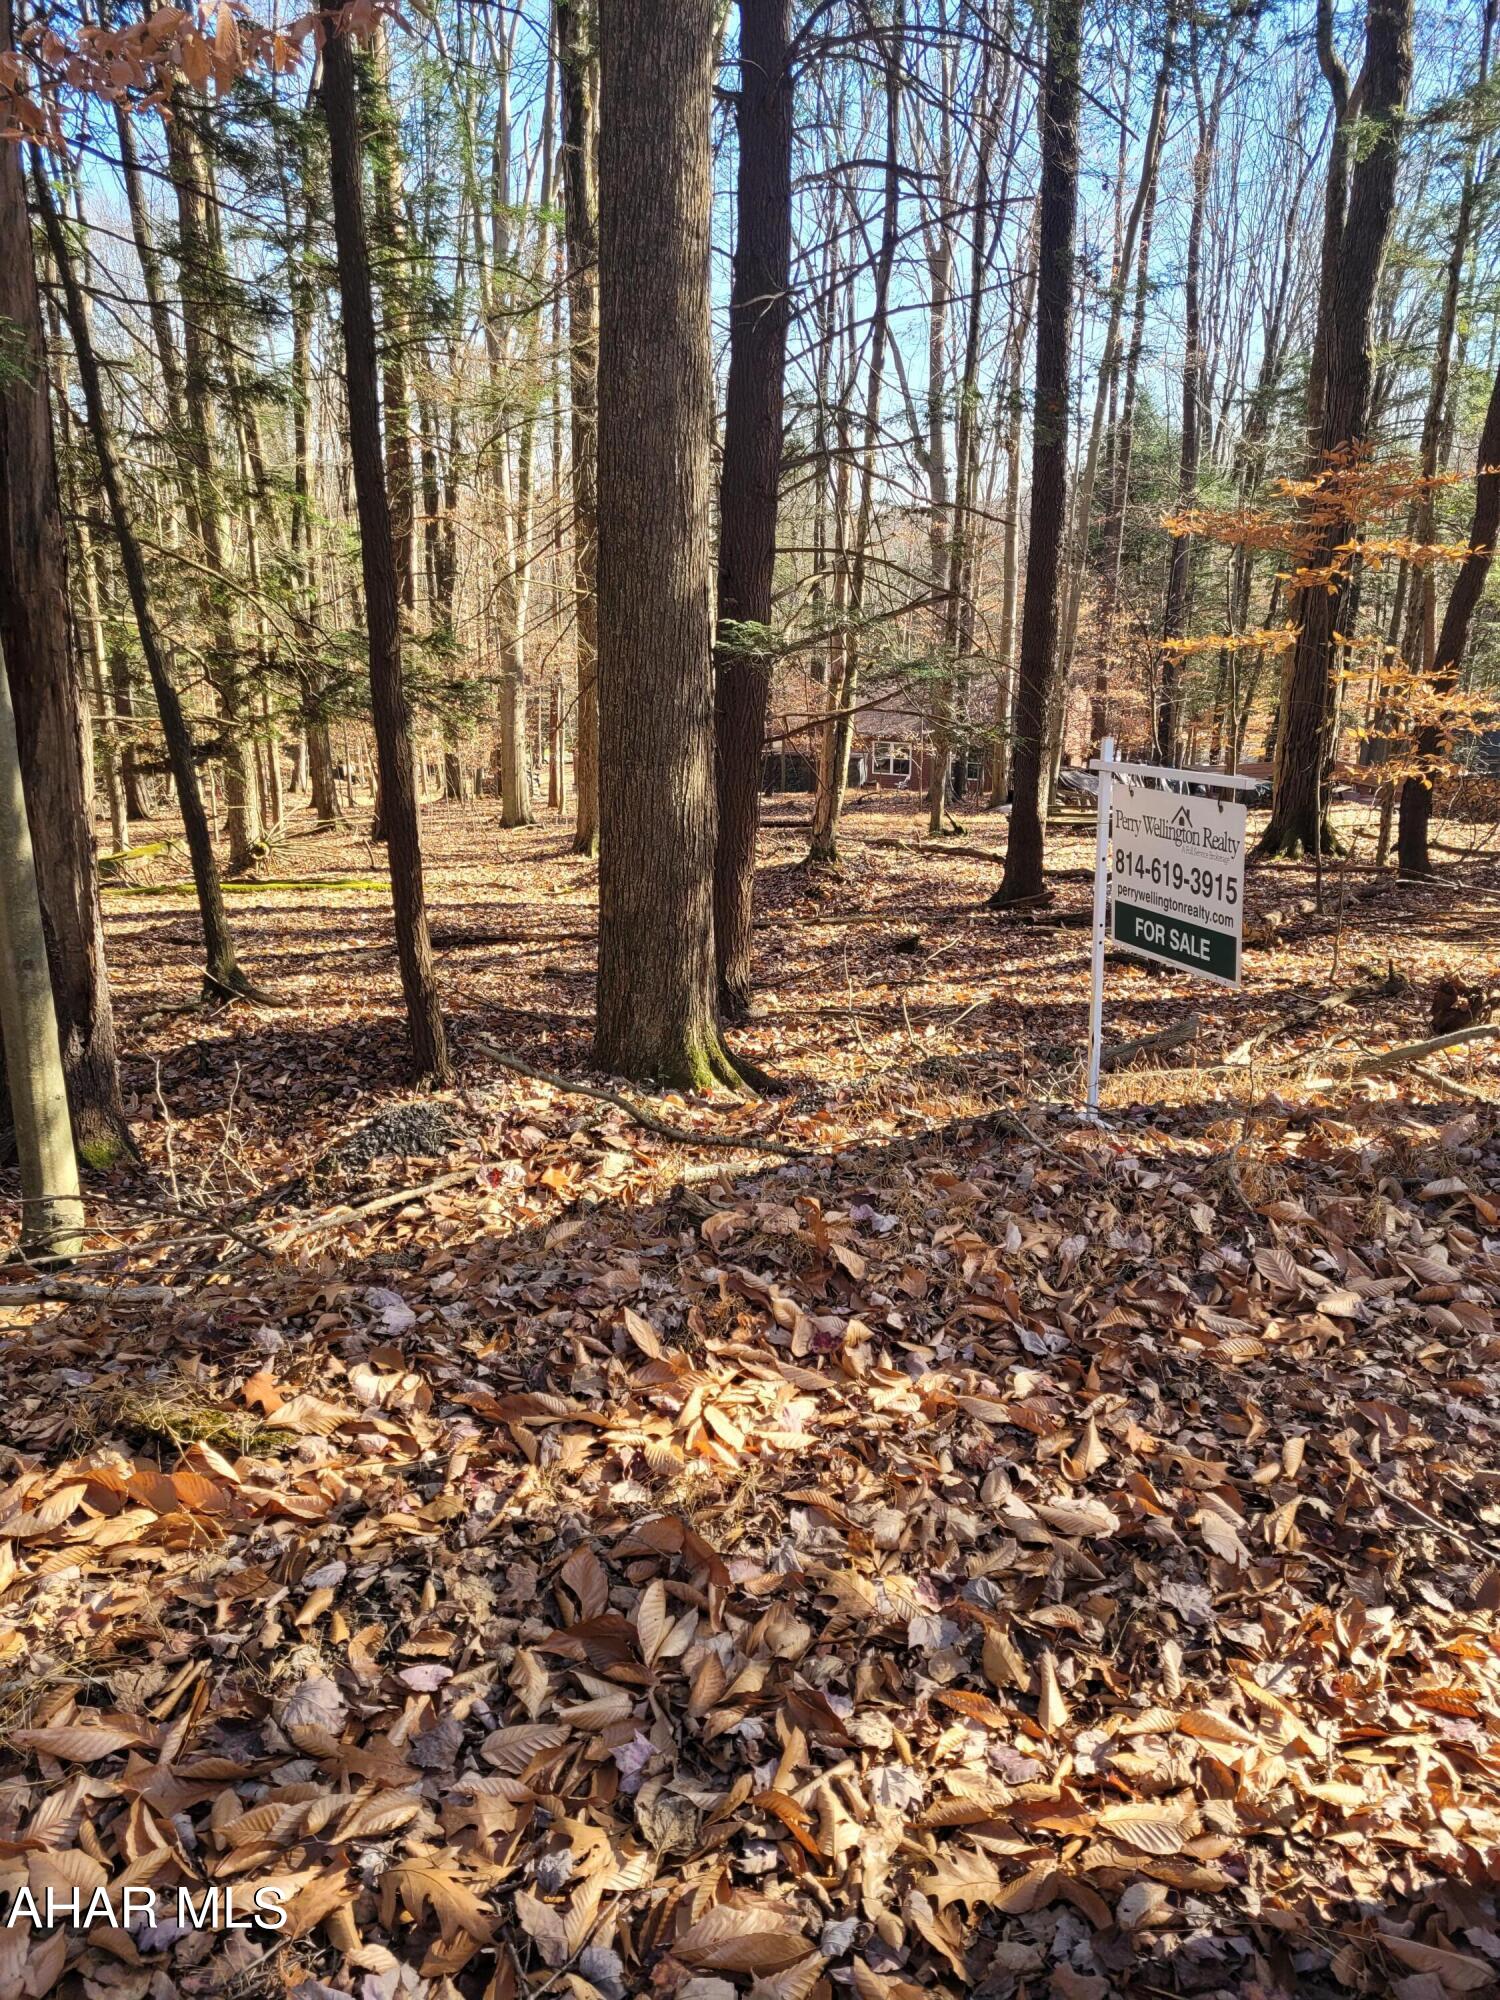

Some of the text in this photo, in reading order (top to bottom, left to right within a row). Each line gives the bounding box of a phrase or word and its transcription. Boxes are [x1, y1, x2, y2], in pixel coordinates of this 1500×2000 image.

[1115, 809, 1240, 859] Perry Wellington Realty
[1115, 849, 1238, 905] 814-619-3915
[1117, 883, 1234, 928] perrywellingtonrealty.com
[1135, 916, 1211, 961] FOR SALE
